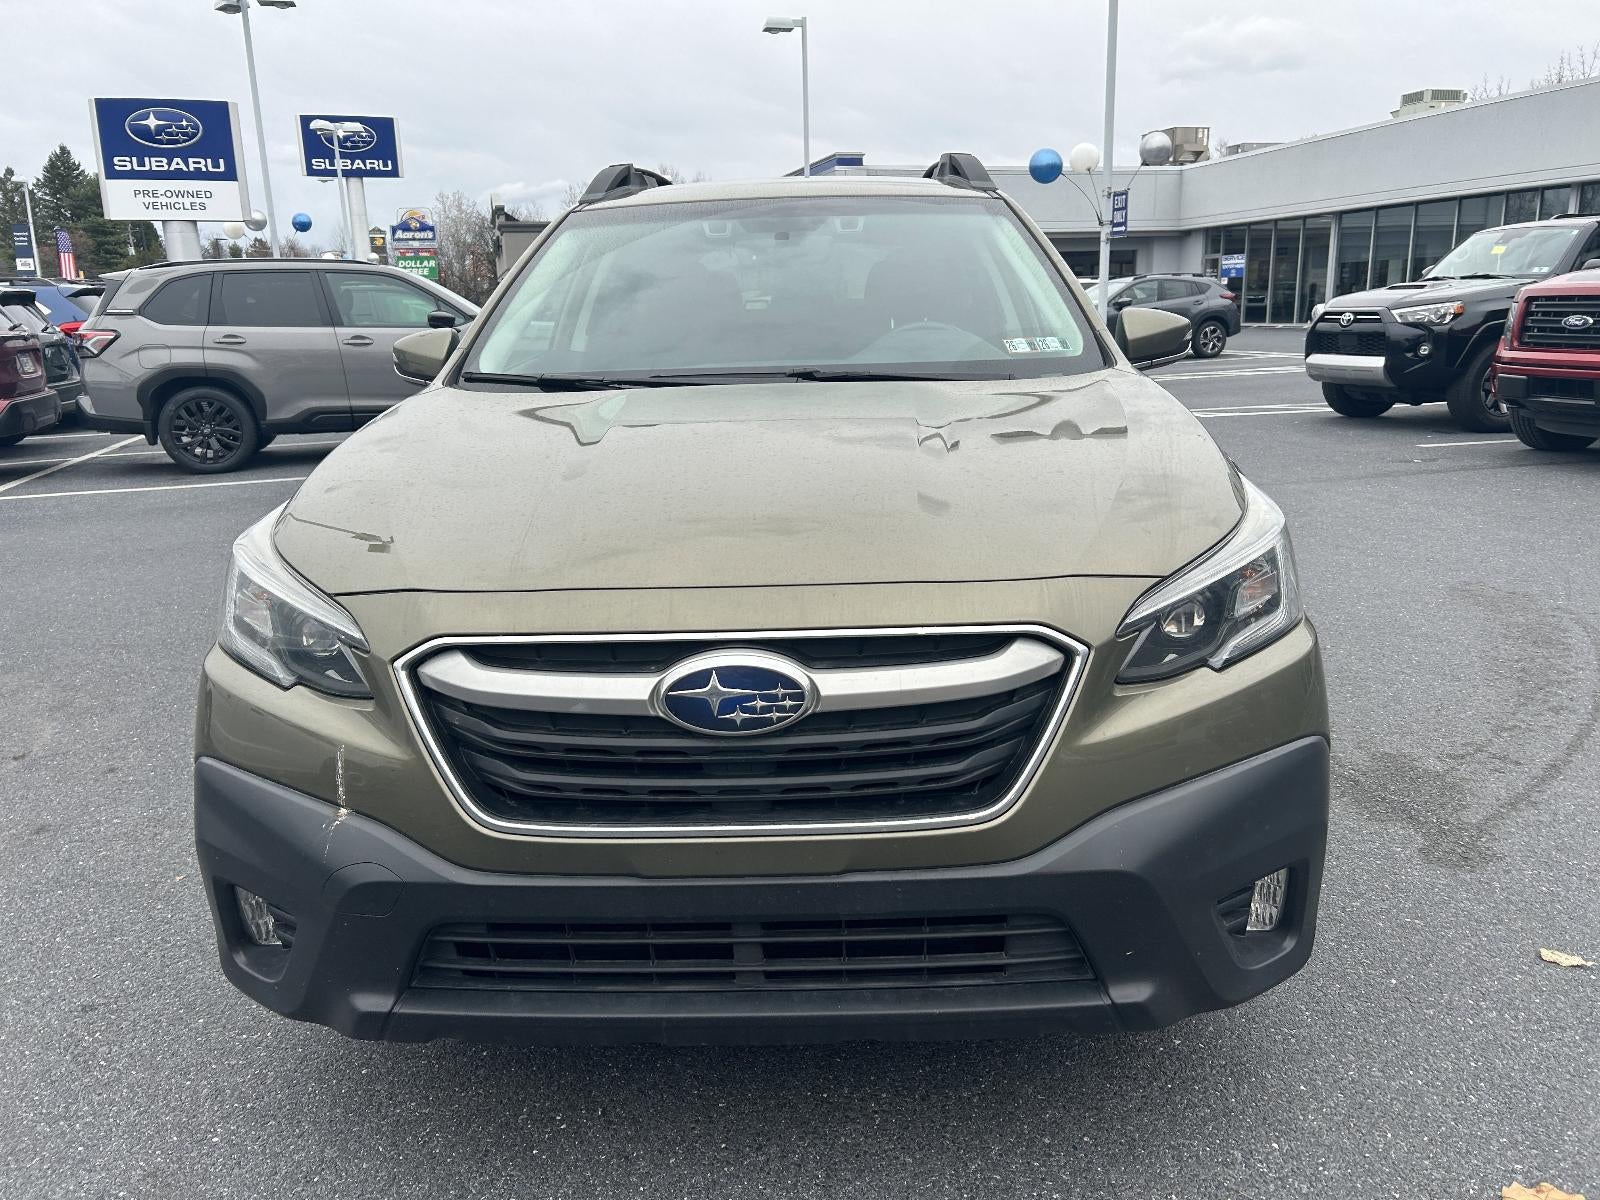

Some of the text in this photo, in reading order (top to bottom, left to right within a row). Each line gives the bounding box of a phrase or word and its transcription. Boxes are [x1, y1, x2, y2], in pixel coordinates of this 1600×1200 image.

[113, 156, 225, 172] SUBARU
[311, 158, 392, 171] SUBARU
[133, 189, 213, 199] PRE-OWNED
[142, 201, 207, 211] VEHICLES
[1114, 195, 1126, 208] EXIT
[394, 230, 433, 239] Aaron's
[398, 260, 436, 268] DOLLAR
